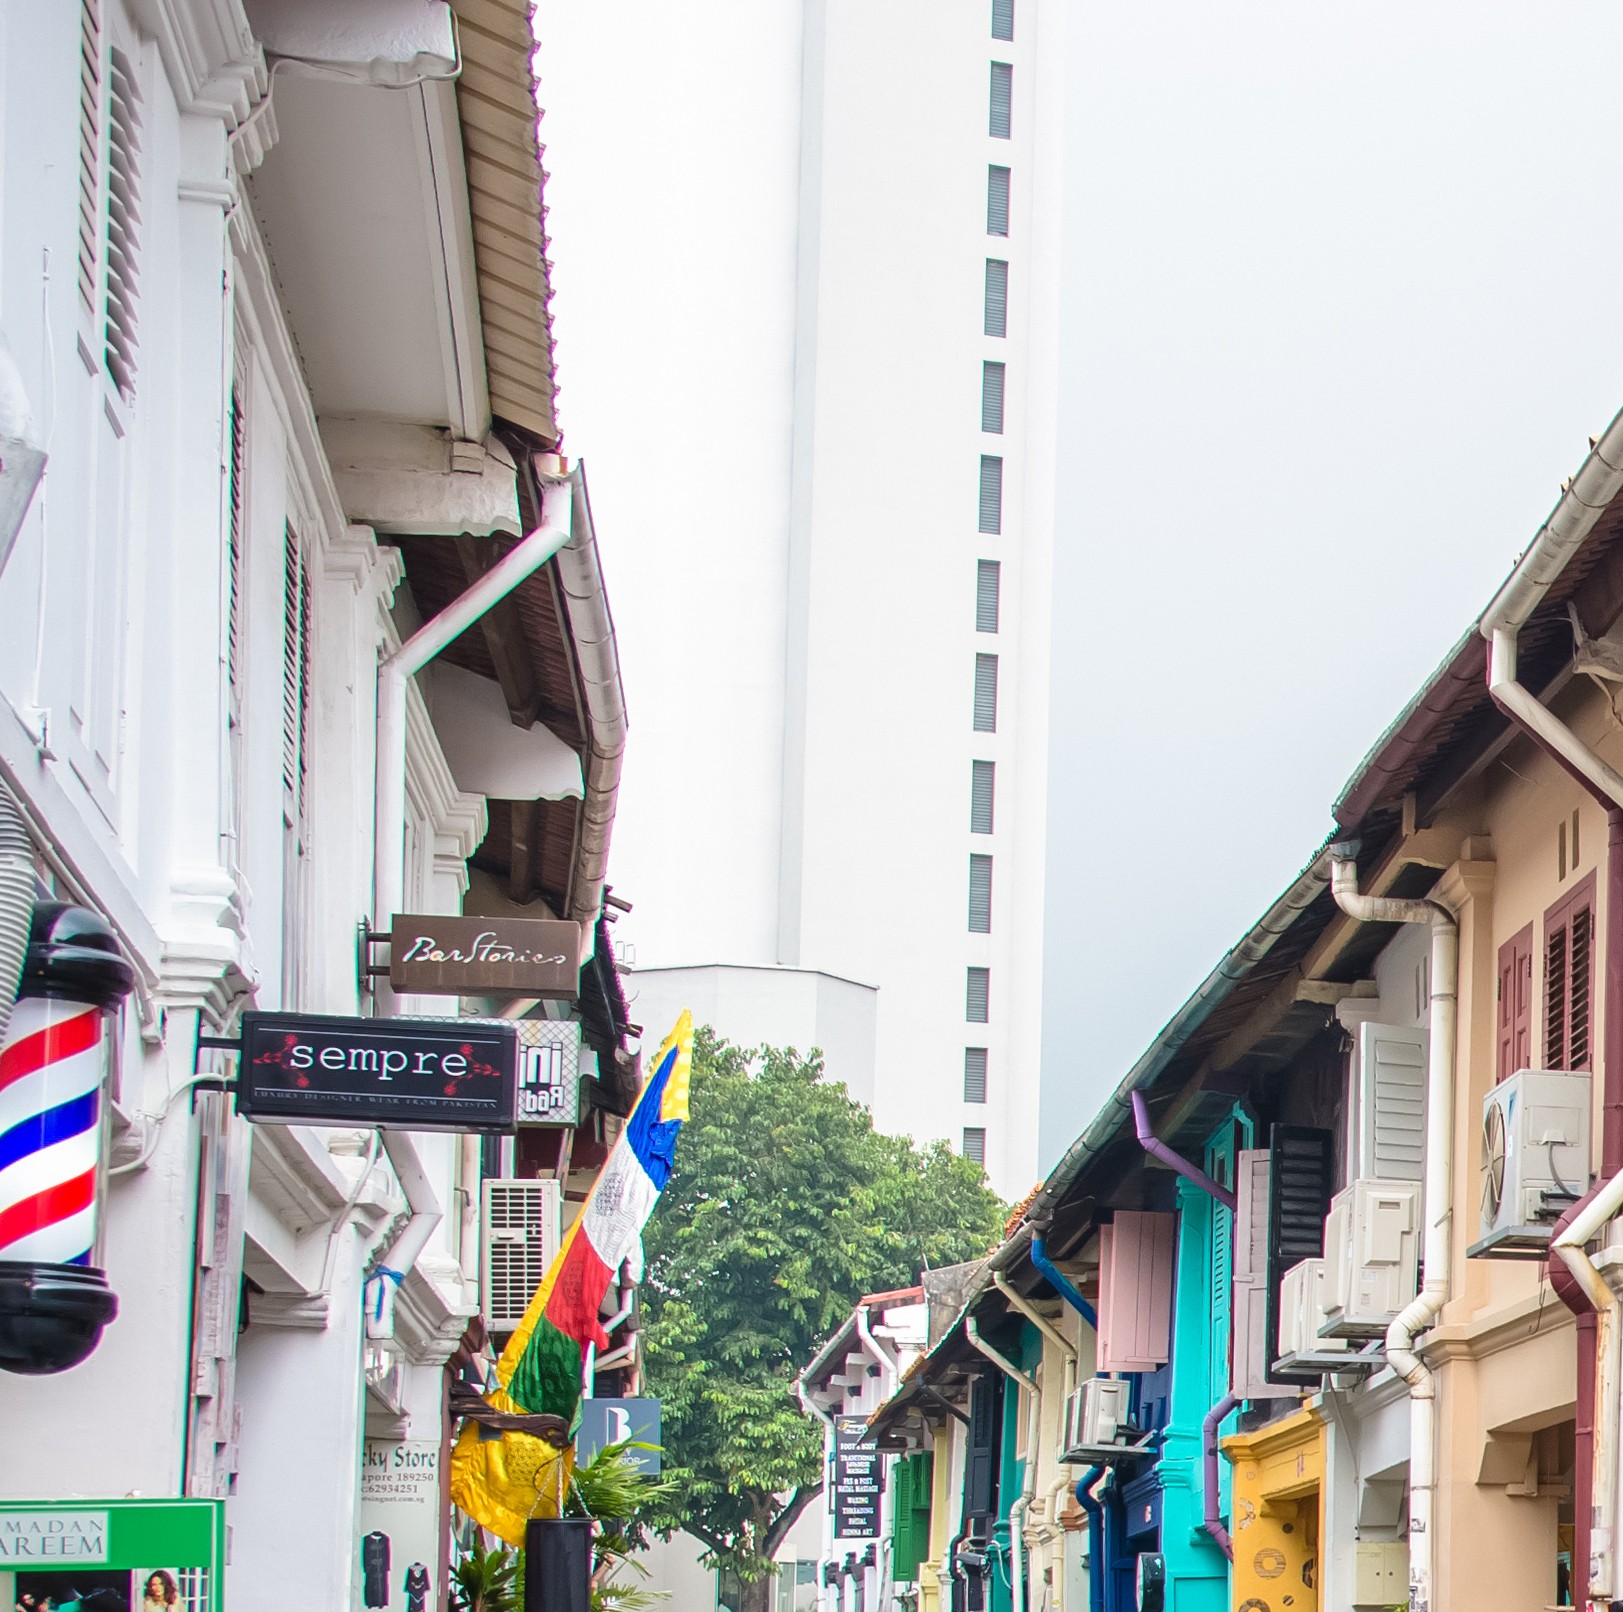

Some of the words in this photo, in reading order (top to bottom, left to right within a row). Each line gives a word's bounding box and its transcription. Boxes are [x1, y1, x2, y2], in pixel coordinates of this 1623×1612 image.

[290, 1045, 468, 1081] sempre
[368, 1096, 400, 1105] WEAR
[405, 1098, 438, 1107] FROM
[442, 1100, 497, 1109] PAKISTAN
[394, 1446, 436, 1468] Store
[397, 1473, 434, 1482] 189250
